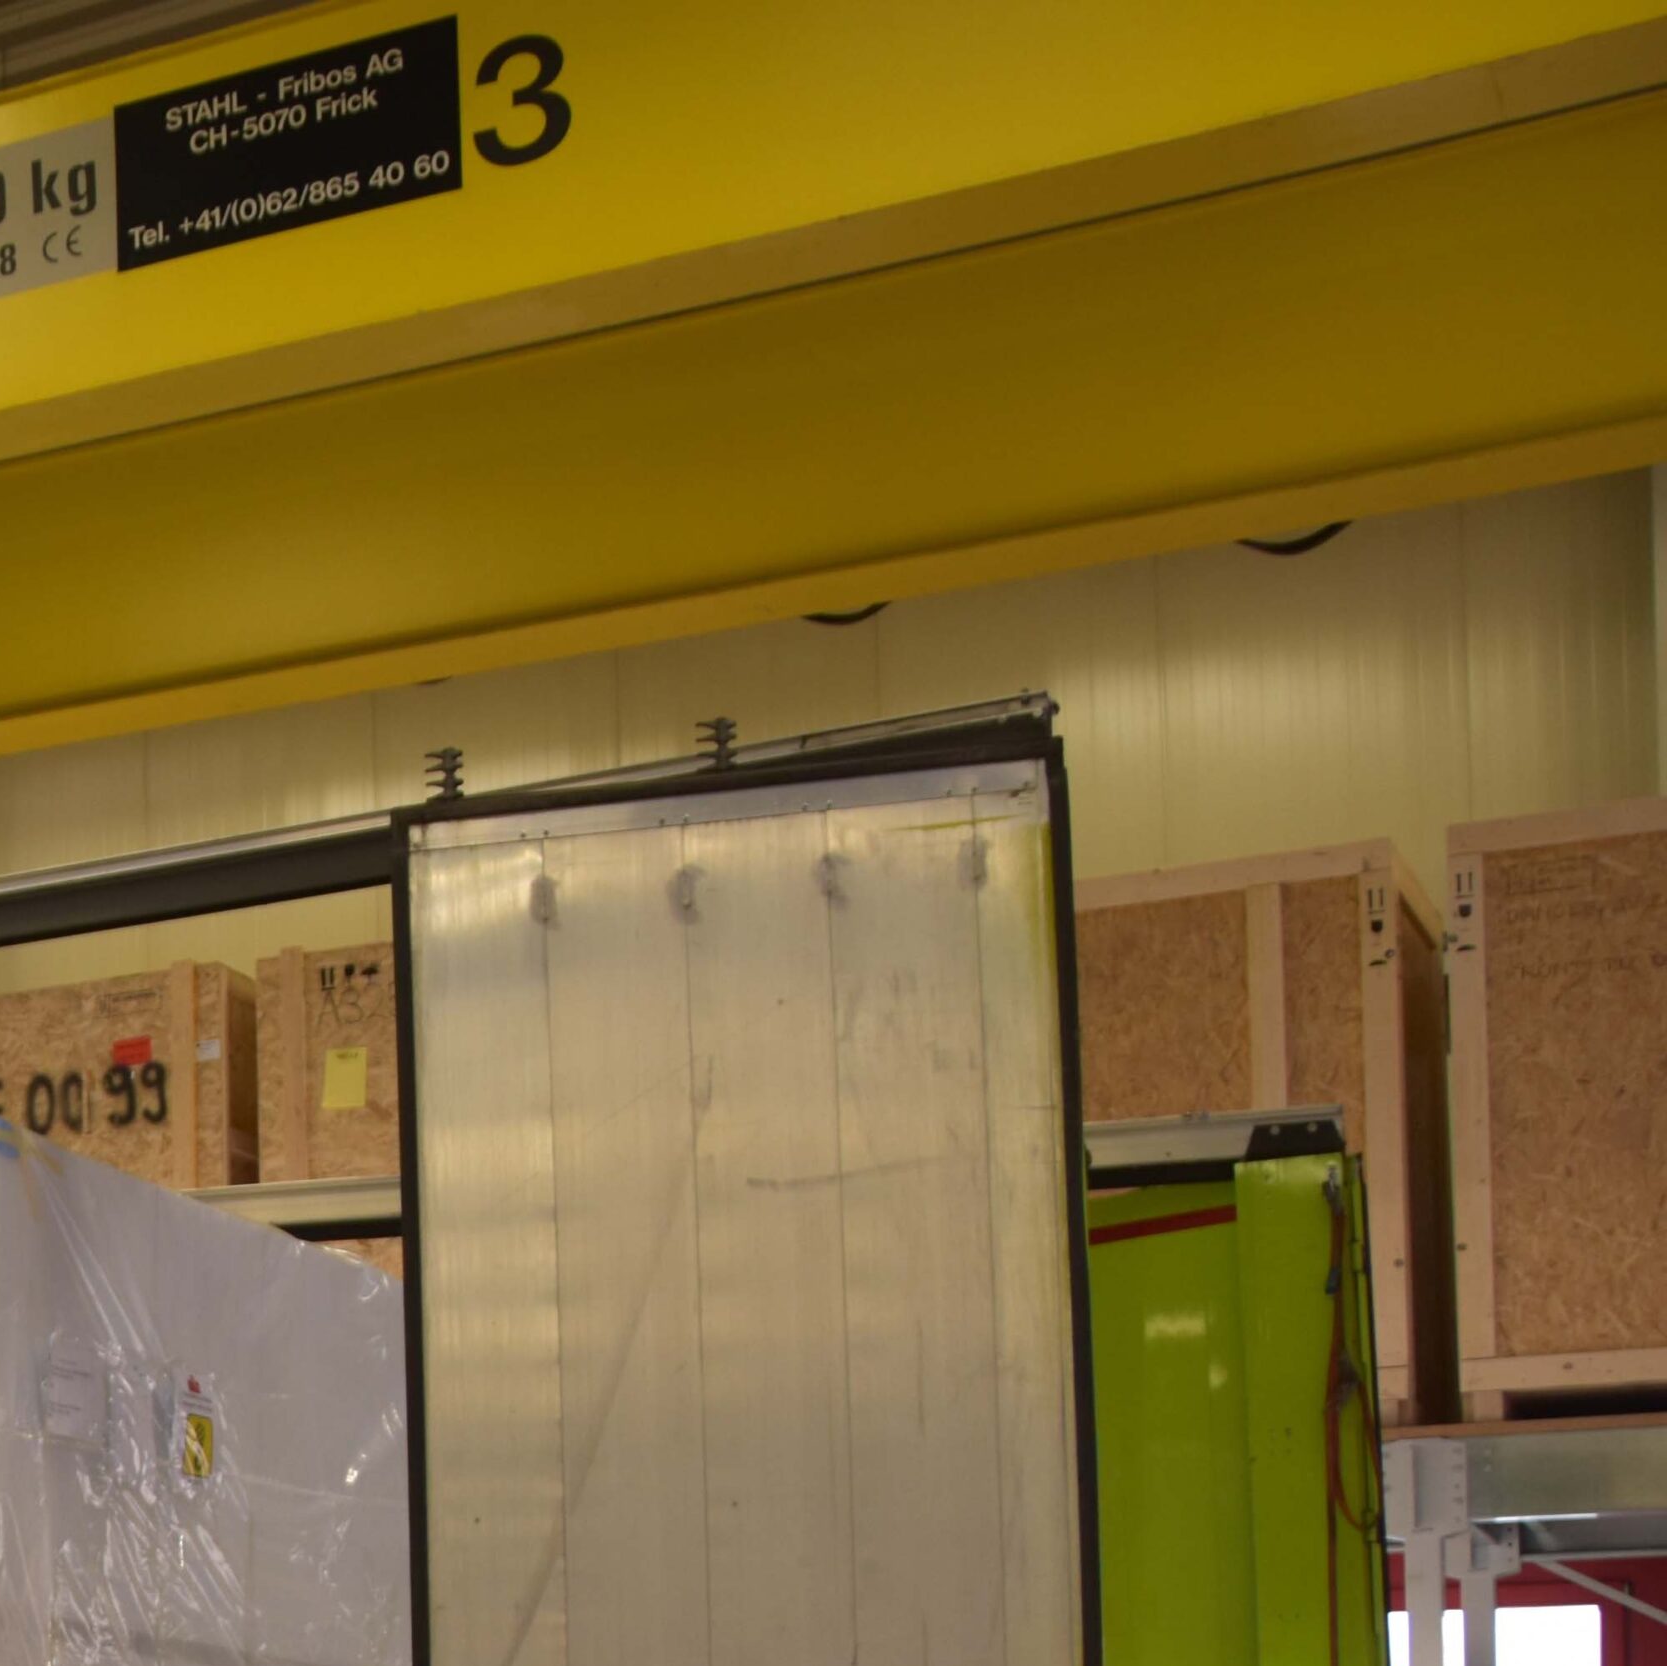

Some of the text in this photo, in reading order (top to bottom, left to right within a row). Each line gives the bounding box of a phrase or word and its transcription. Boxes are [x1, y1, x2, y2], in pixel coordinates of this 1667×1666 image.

[165, 90, 248, 132] STAHL
[277, 62, 356, 104] Fribos
[366, 47, 404, 78] AG
[188, 85, 378, 155] CH-5070 Frick
[472, 33, 572, 167] 3
[31, 154, 97, 217] kg
[127, 150, 450, 251] Tel. +41/(0)62/865 40 60
